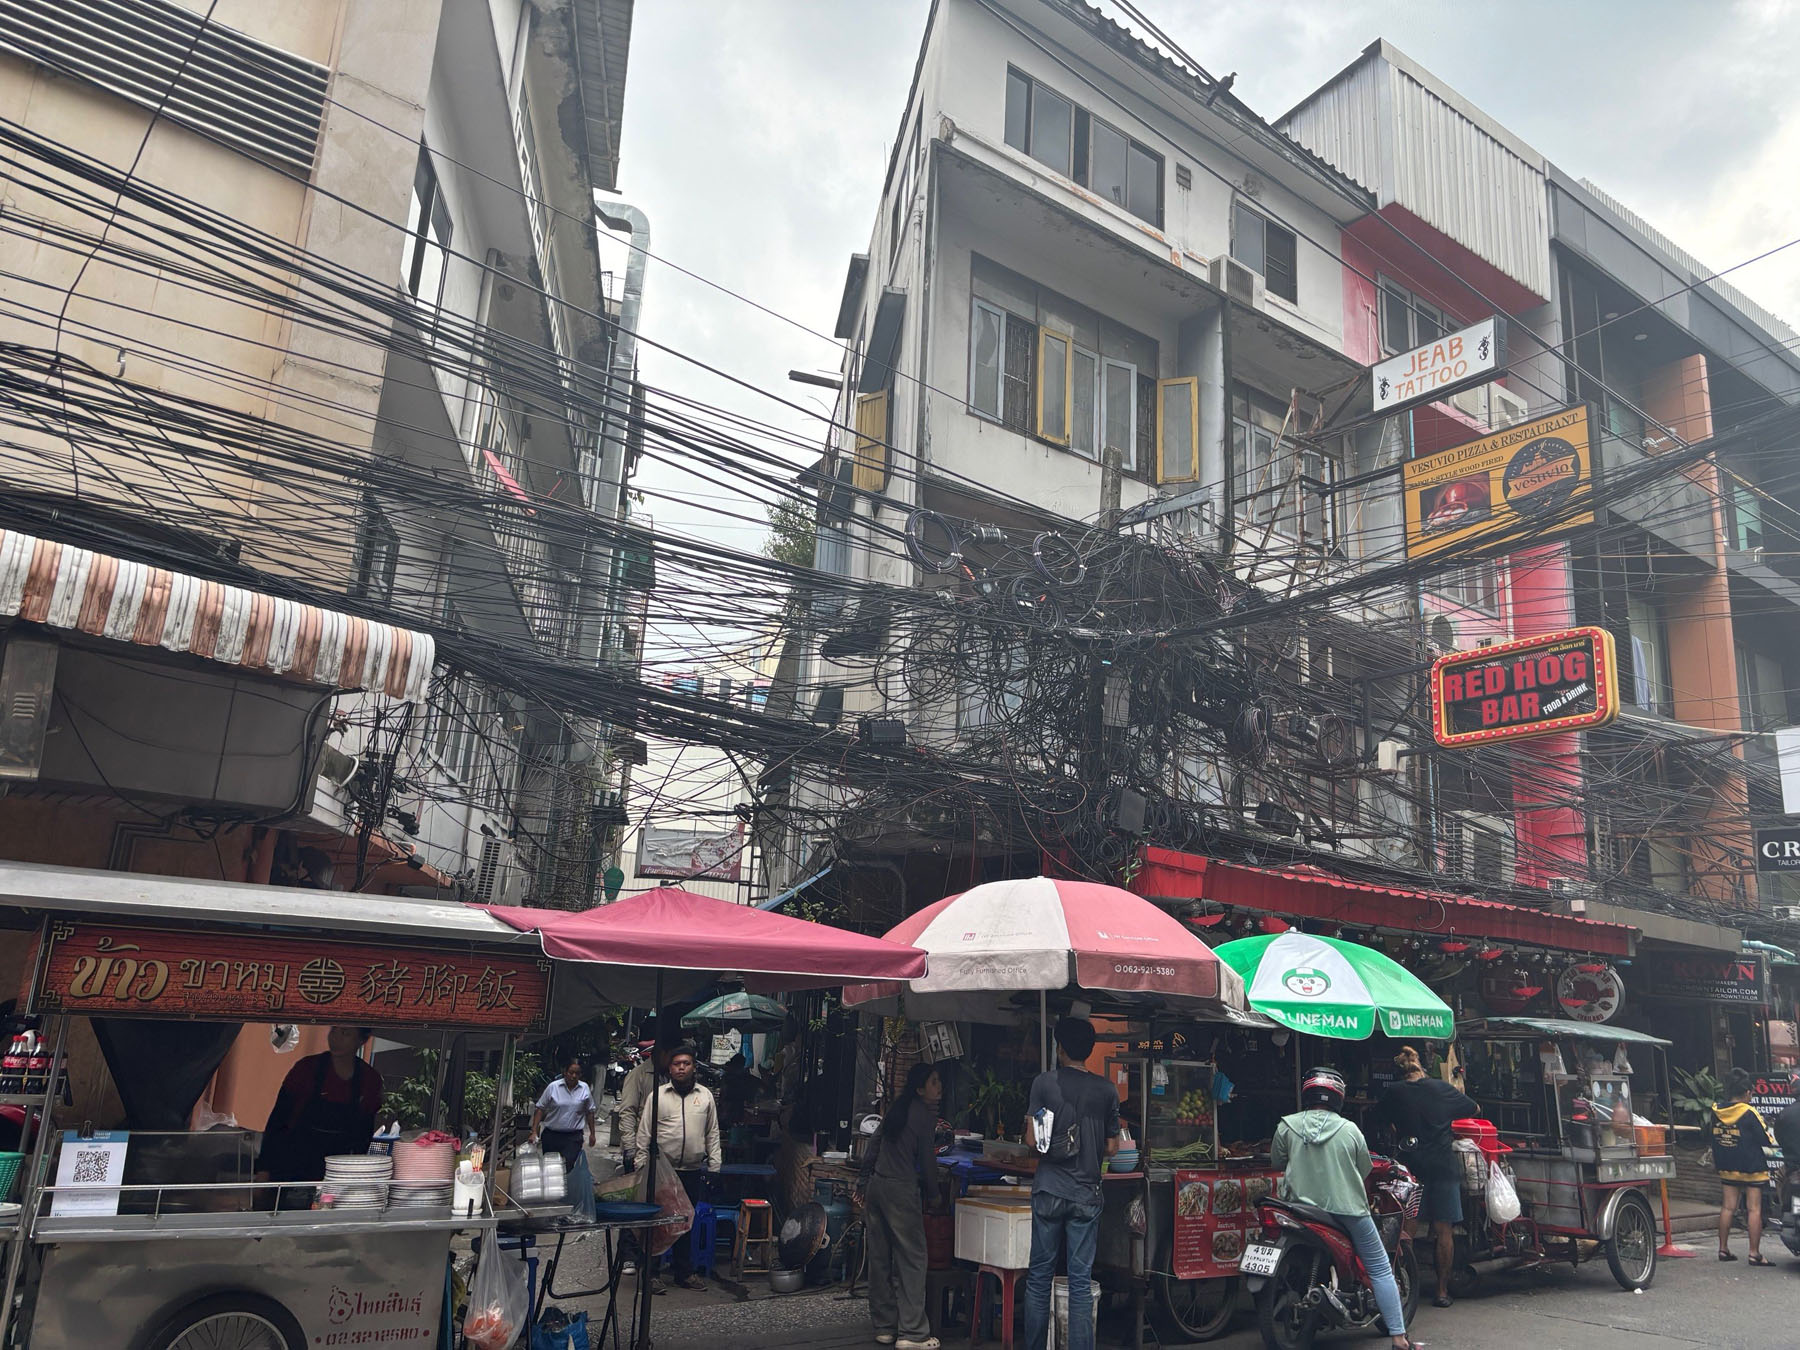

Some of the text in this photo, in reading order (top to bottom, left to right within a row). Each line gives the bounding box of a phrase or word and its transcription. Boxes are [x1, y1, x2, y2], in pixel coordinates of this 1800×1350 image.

[1403, 336, 1464, 377] JEAB
[1394, 360, 1467, 400] TATTOO
[1411, 453, 1455, 474] VESUVIO
[1457, 443, 1488, 461] PIZZA
[1490, 439, 1499, 449] &
[1501, 413, 1578, 447] RESTAURANT
[1459, 463, 1480, 473] WOOD
[1481, 456, 1504, 467] FIRED
[1444, 651, 1587, 702] RED HOG
[1482, 692, 1540, 725] BAR
[1543, 698, 1562, 715] FOOD
[1567, 683, 1588, 702] DRINK
[70, 936, 290, 1011] ข้าว ขาหมู
[358, 958, 522, 1012] 豬腳飯
[1122, 964, 1175, 976] 062-921-5380
[1244, 1262, 1271, 1273] 4305
